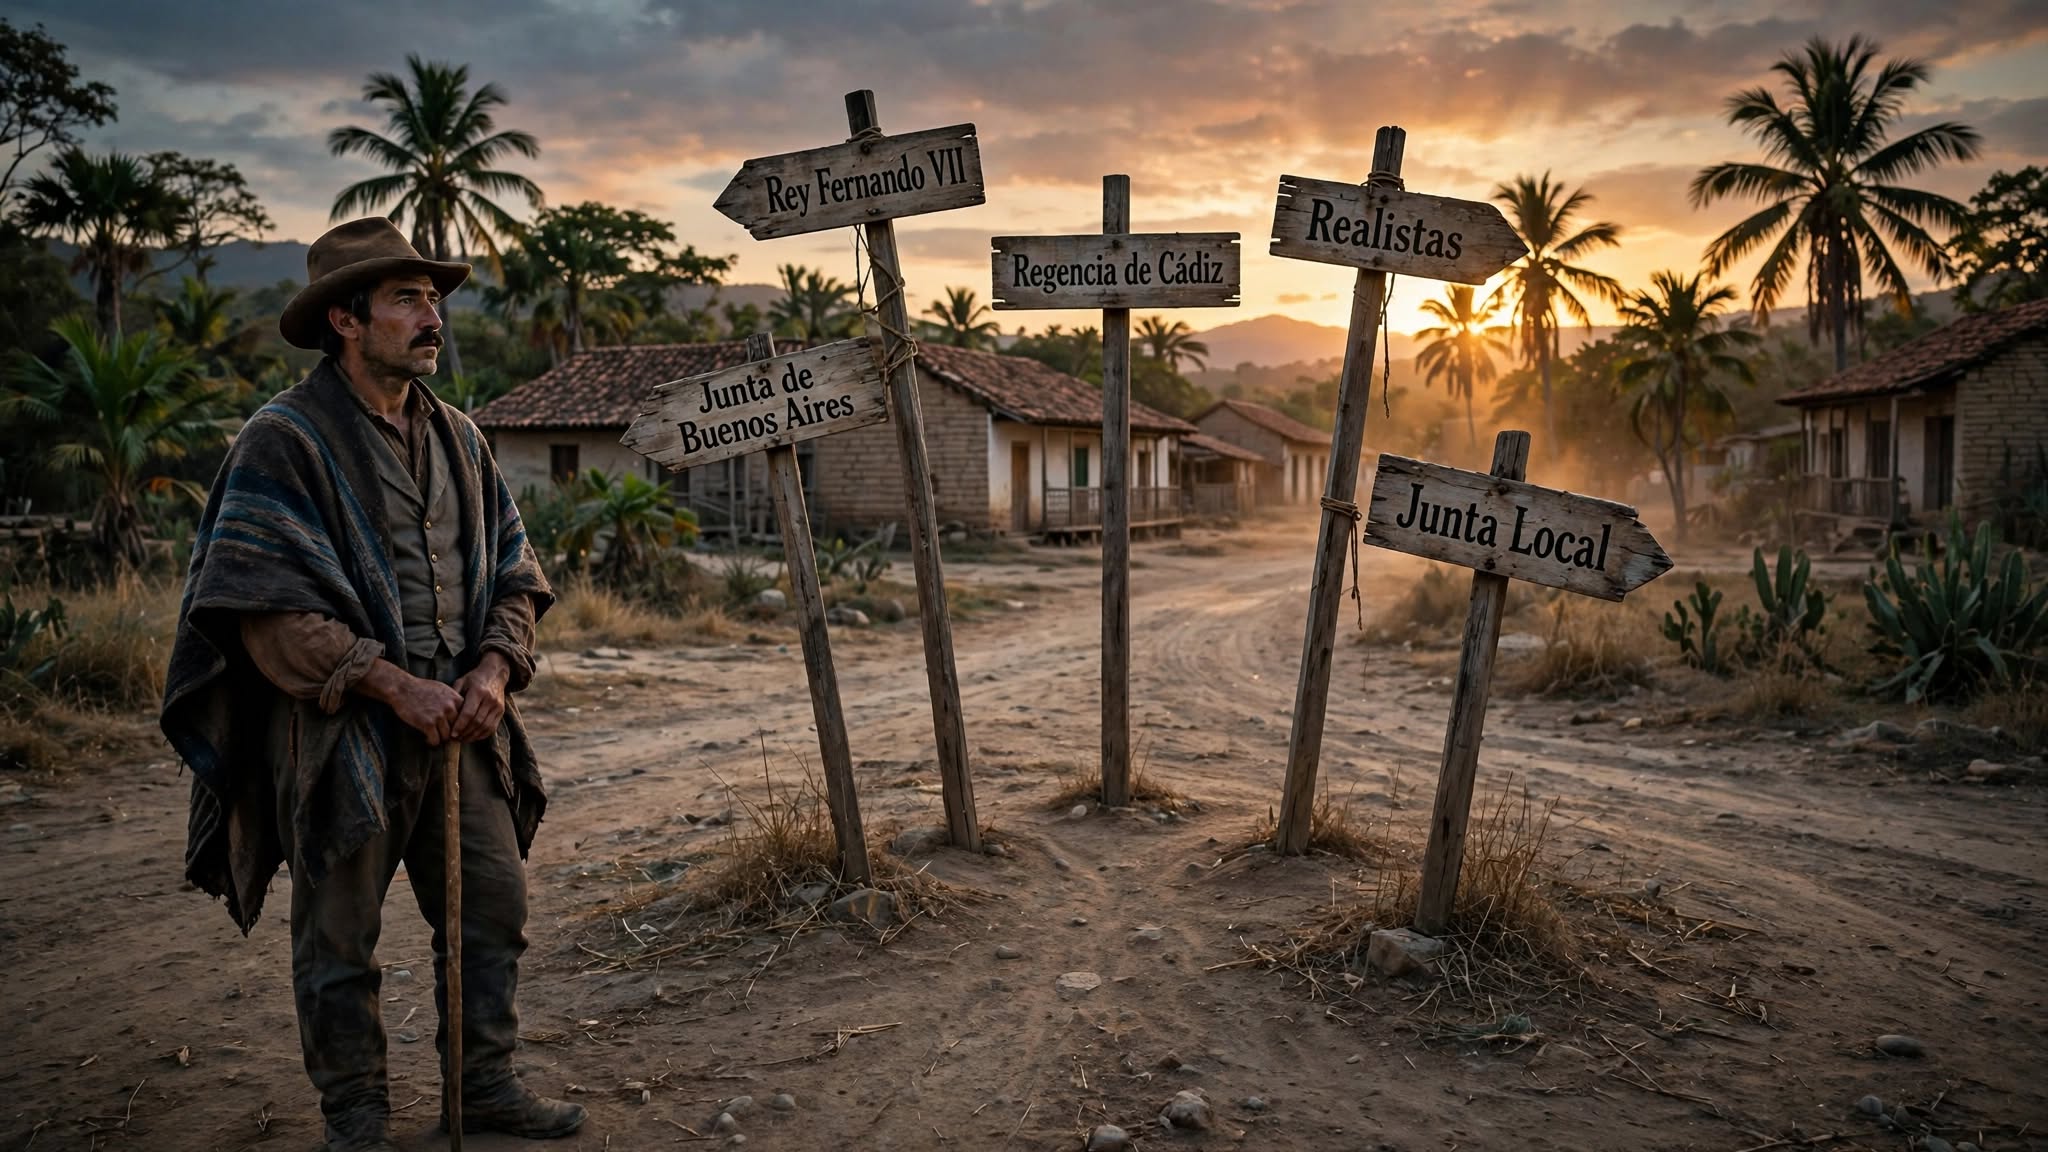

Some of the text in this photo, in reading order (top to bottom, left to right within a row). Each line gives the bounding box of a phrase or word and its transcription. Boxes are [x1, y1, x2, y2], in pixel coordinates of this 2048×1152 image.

[764, 146, 967, 217] Rey Fernando VII
[1305, 198, 1463, 260] Realistas
[1012, 250, 1224, 294] Regencia de Cádiz
[699, 362, 814, 414] Junta de
[677, 394, 855, 454] Buenos Aires
[1396, 482, 1612, 572] Junta Local
